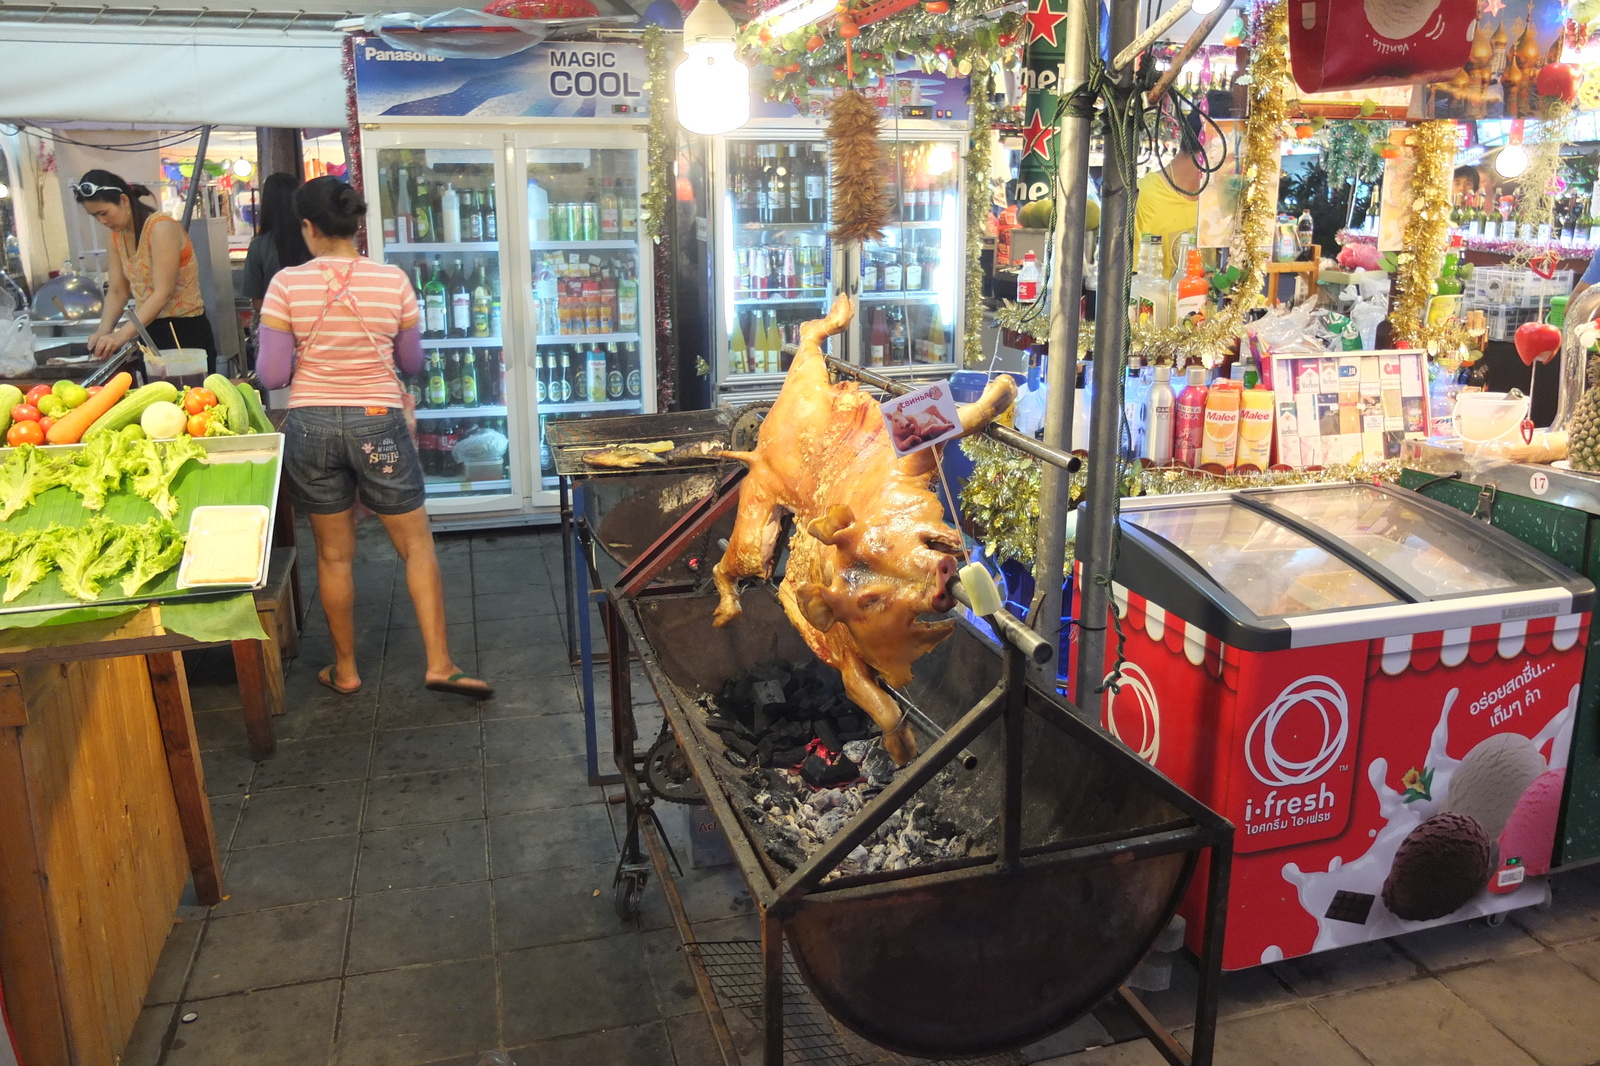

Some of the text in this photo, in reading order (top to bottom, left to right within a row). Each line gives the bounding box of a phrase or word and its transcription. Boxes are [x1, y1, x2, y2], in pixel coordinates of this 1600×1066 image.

[549, 51, 616, 68] MAGIC
[549, 71, 642, 98] COOL
[1206, 411, 1237, 422] Malee
[1239, 409, 1270, 421] Malee
[1533, 477, 1546, 490] 17
